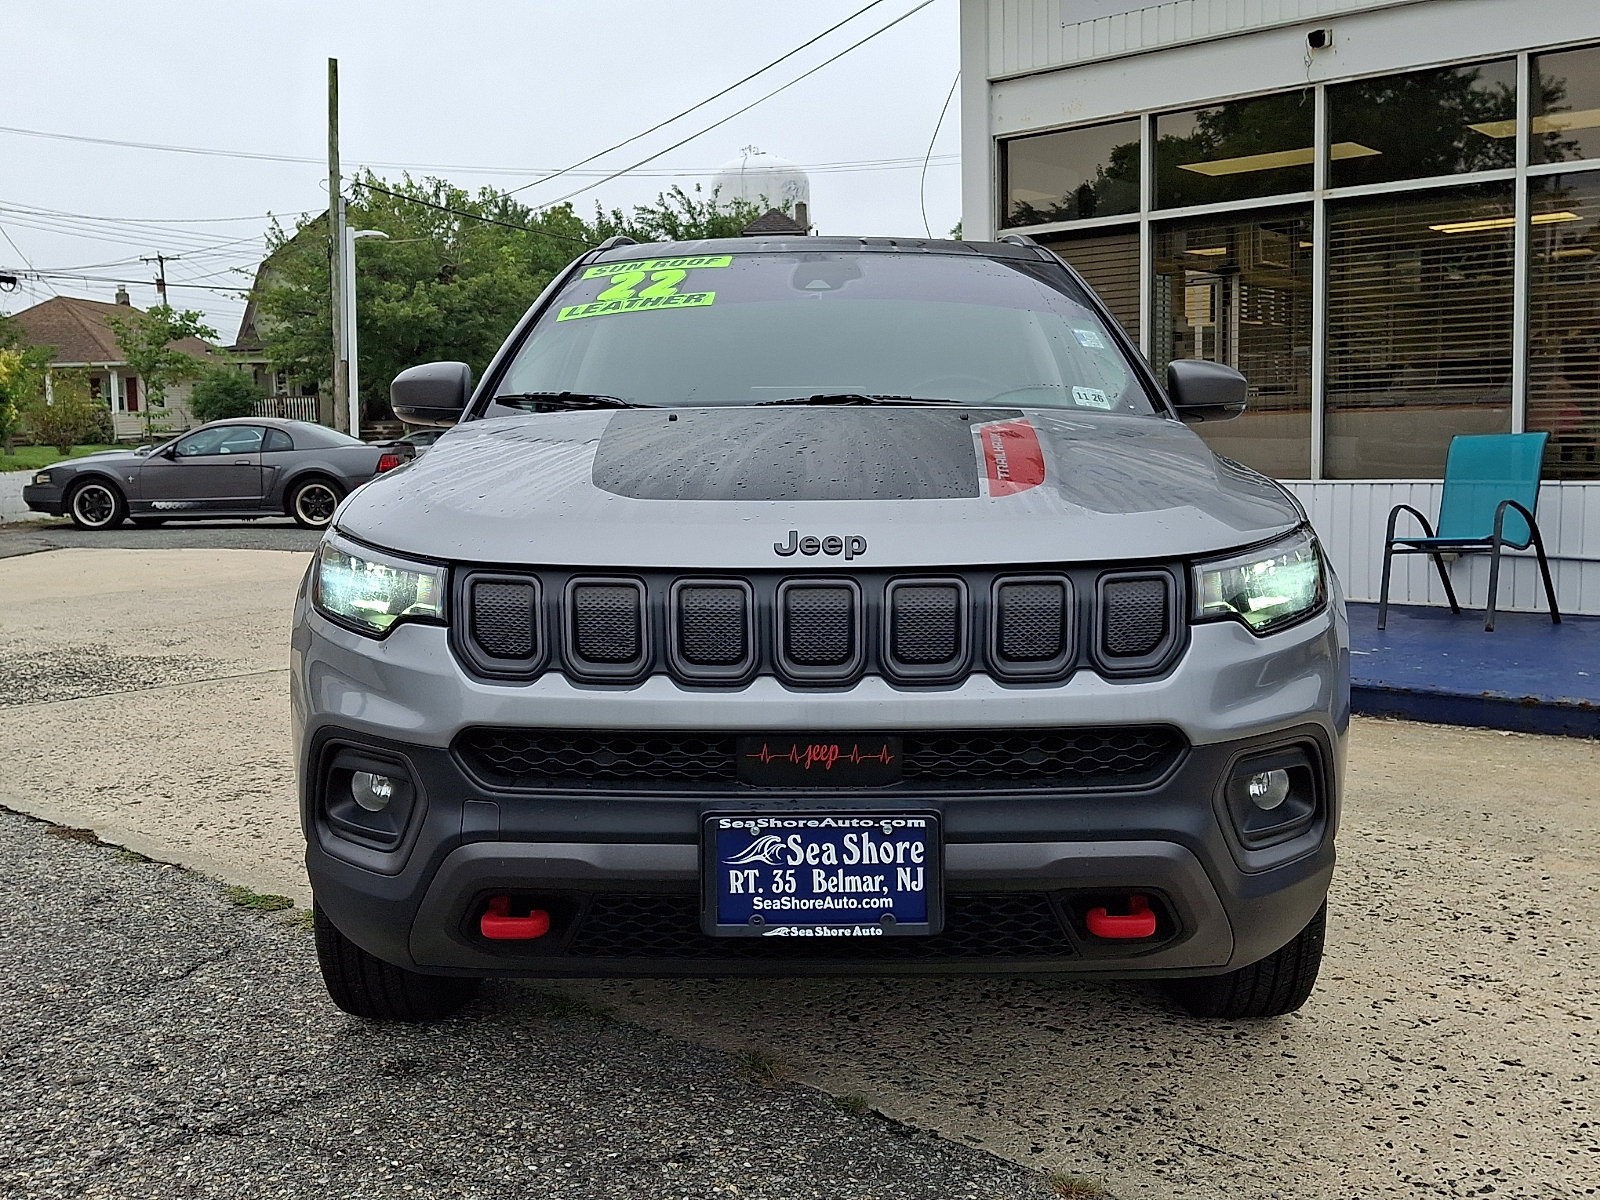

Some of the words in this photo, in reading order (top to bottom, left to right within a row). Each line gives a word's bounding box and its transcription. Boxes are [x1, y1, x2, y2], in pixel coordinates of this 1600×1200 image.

[592, 262, 645, 276] SUN
[651, 257, 722, 269] ROOF
[596, 269, 687, 301] 22
[564, 293, 708, 317] LEATHER
[1076, 391, 1089, 401] 11
[1092, 393, 1104, 403] 26
[773, 530, 868, 560] Jeep
[804, 744, 840, 770] jeep
[719, 818, 926, 829] SeaShoreAuto.com
[787, 834, 838, 866] Sea
[843, 831, 925, 865] Shore
[729, 869, 764, 894] RT.
[771, 869, 797, 894] 35
[812, 868, 889, 895] Belmar,
[896, 867, 924, 892] NJ
[753, 896, 894, 910] SeaShoreAuto.com
[789, 926, 813, 937] Sea
[814, 926, 851, 937] Shore
[852, 926, 883, 937] Auto
